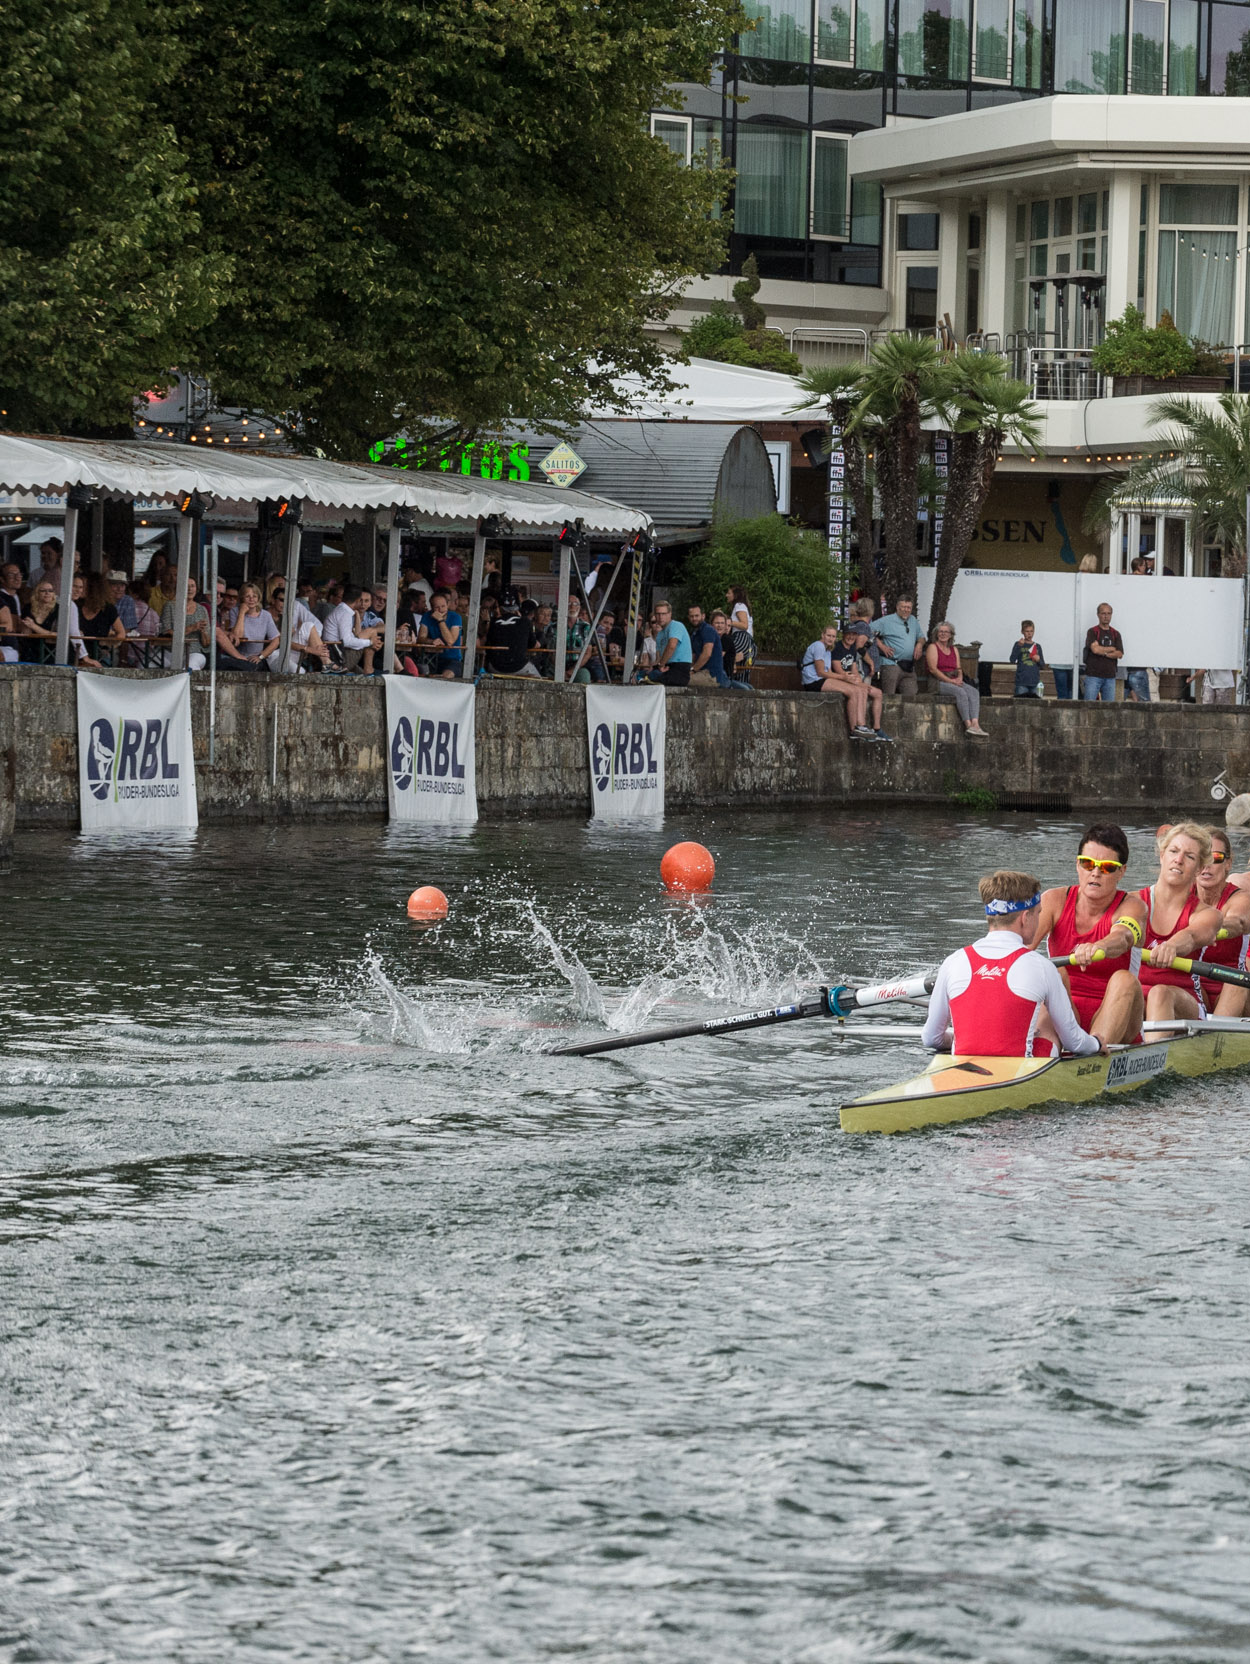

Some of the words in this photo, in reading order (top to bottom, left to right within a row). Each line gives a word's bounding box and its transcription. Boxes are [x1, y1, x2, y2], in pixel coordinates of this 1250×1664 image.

[545, 460, 580, 469] SALITOS
[117, 719, 179, 780] RBL
[417, 719, 465, 779] RBL
[614, 723, 657, 774] RBL
[875, 985, 909, 1000] Melitta
